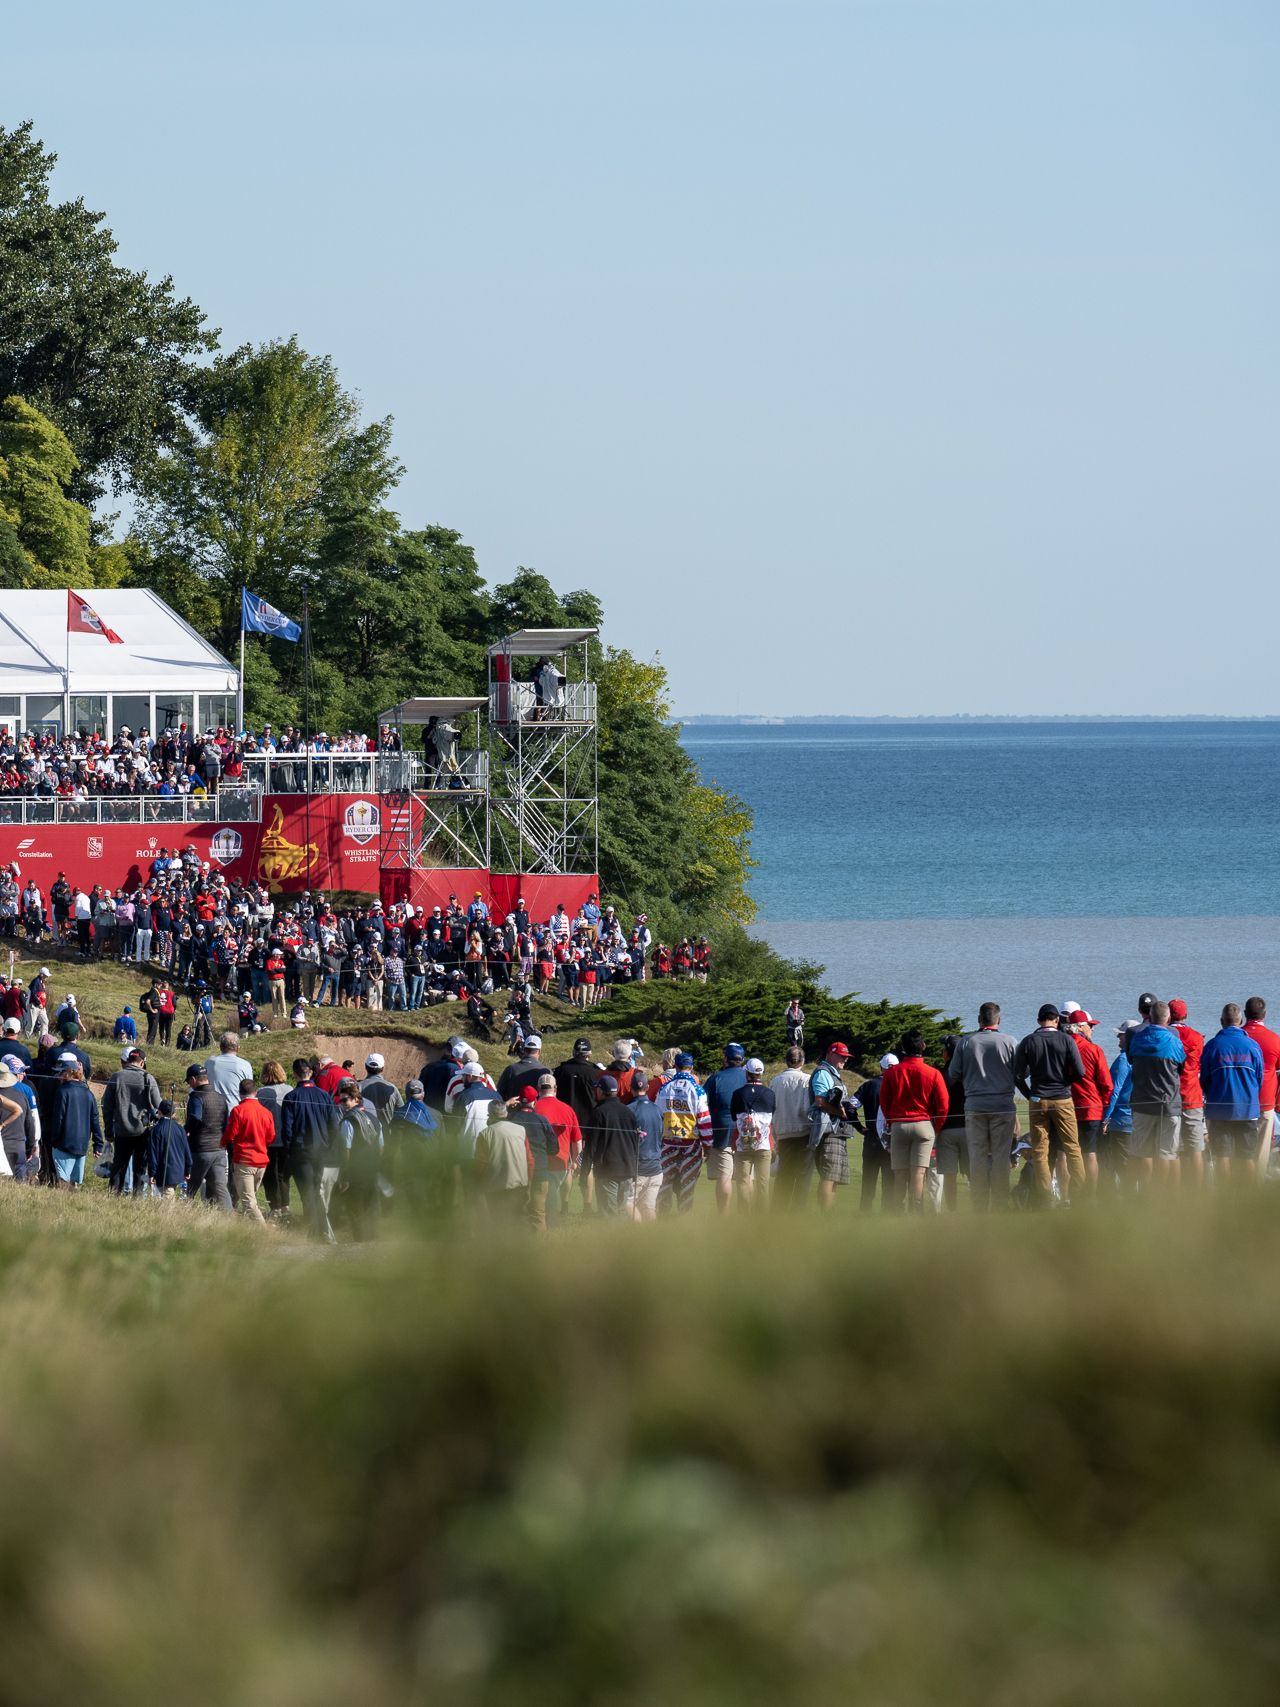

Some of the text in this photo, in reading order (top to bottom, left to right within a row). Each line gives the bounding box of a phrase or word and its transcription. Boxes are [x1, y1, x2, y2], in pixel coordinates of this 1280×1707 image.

[345, 825, 366, 833] RYDER
[136, 850, 161, 858] ROLE
[665, 1099, 691, 1111] USA
